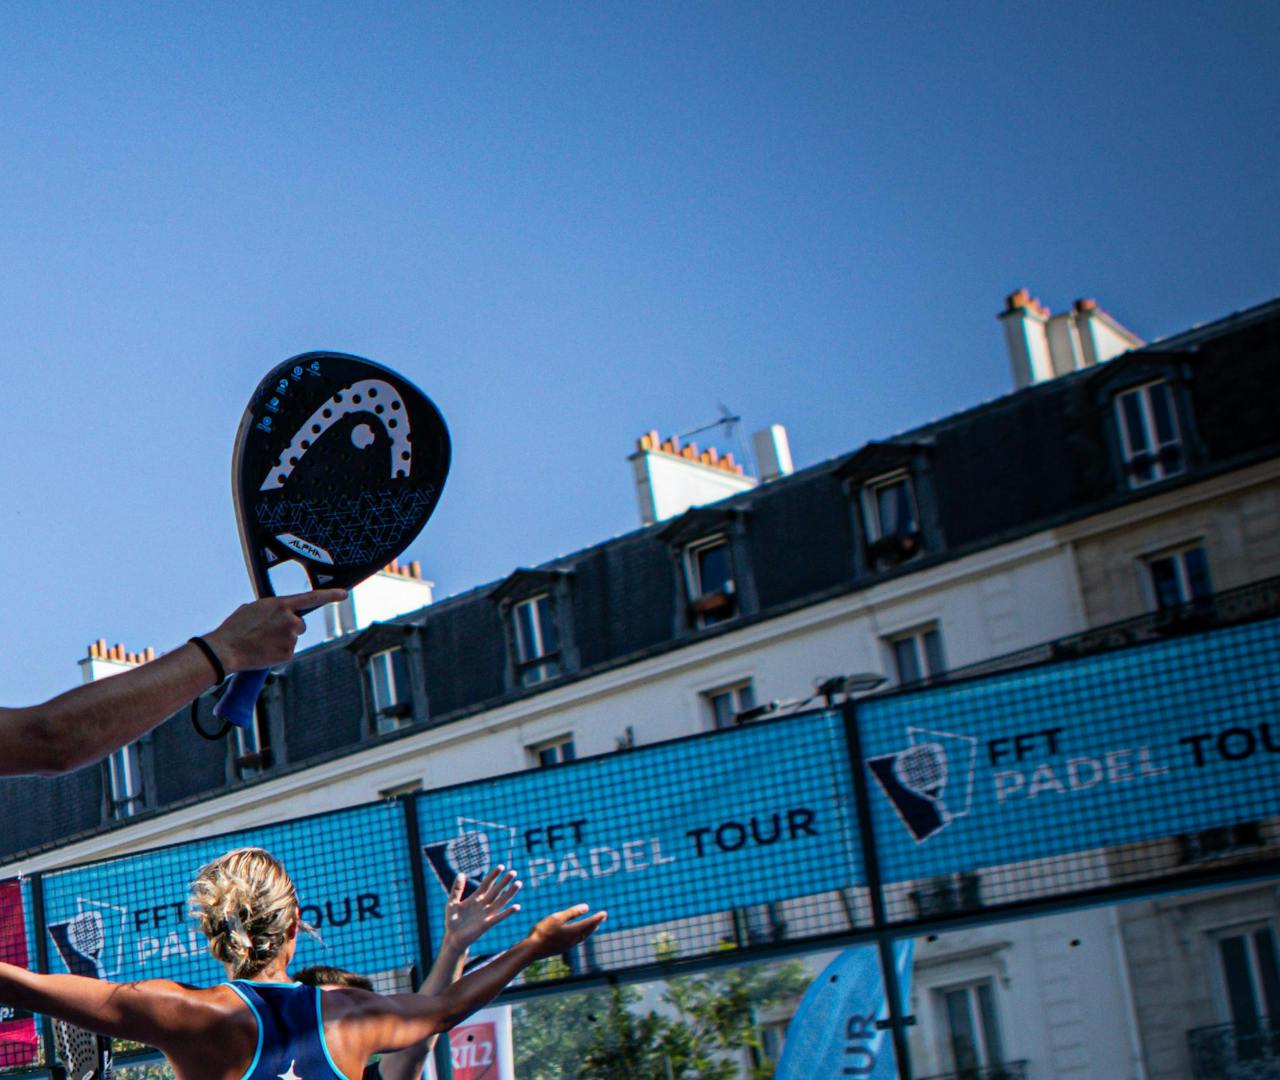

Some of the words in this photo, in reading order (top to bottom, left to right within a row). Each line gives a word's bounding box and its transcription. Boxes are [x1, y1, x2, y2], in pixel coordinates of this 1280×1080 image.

[989, 727, 1064, 766] FFT
[993, 745, 1169, 803] PADEL
[1179, 722, 1280, 768] TOU
[524, 819, 587, 853] FFT
[528, 837, 676, 889] PADEL
[686, 808, 819, 858] TOUR
[133, 902, 185, 932] FFT
[299, 892, 385, 929] OUR
